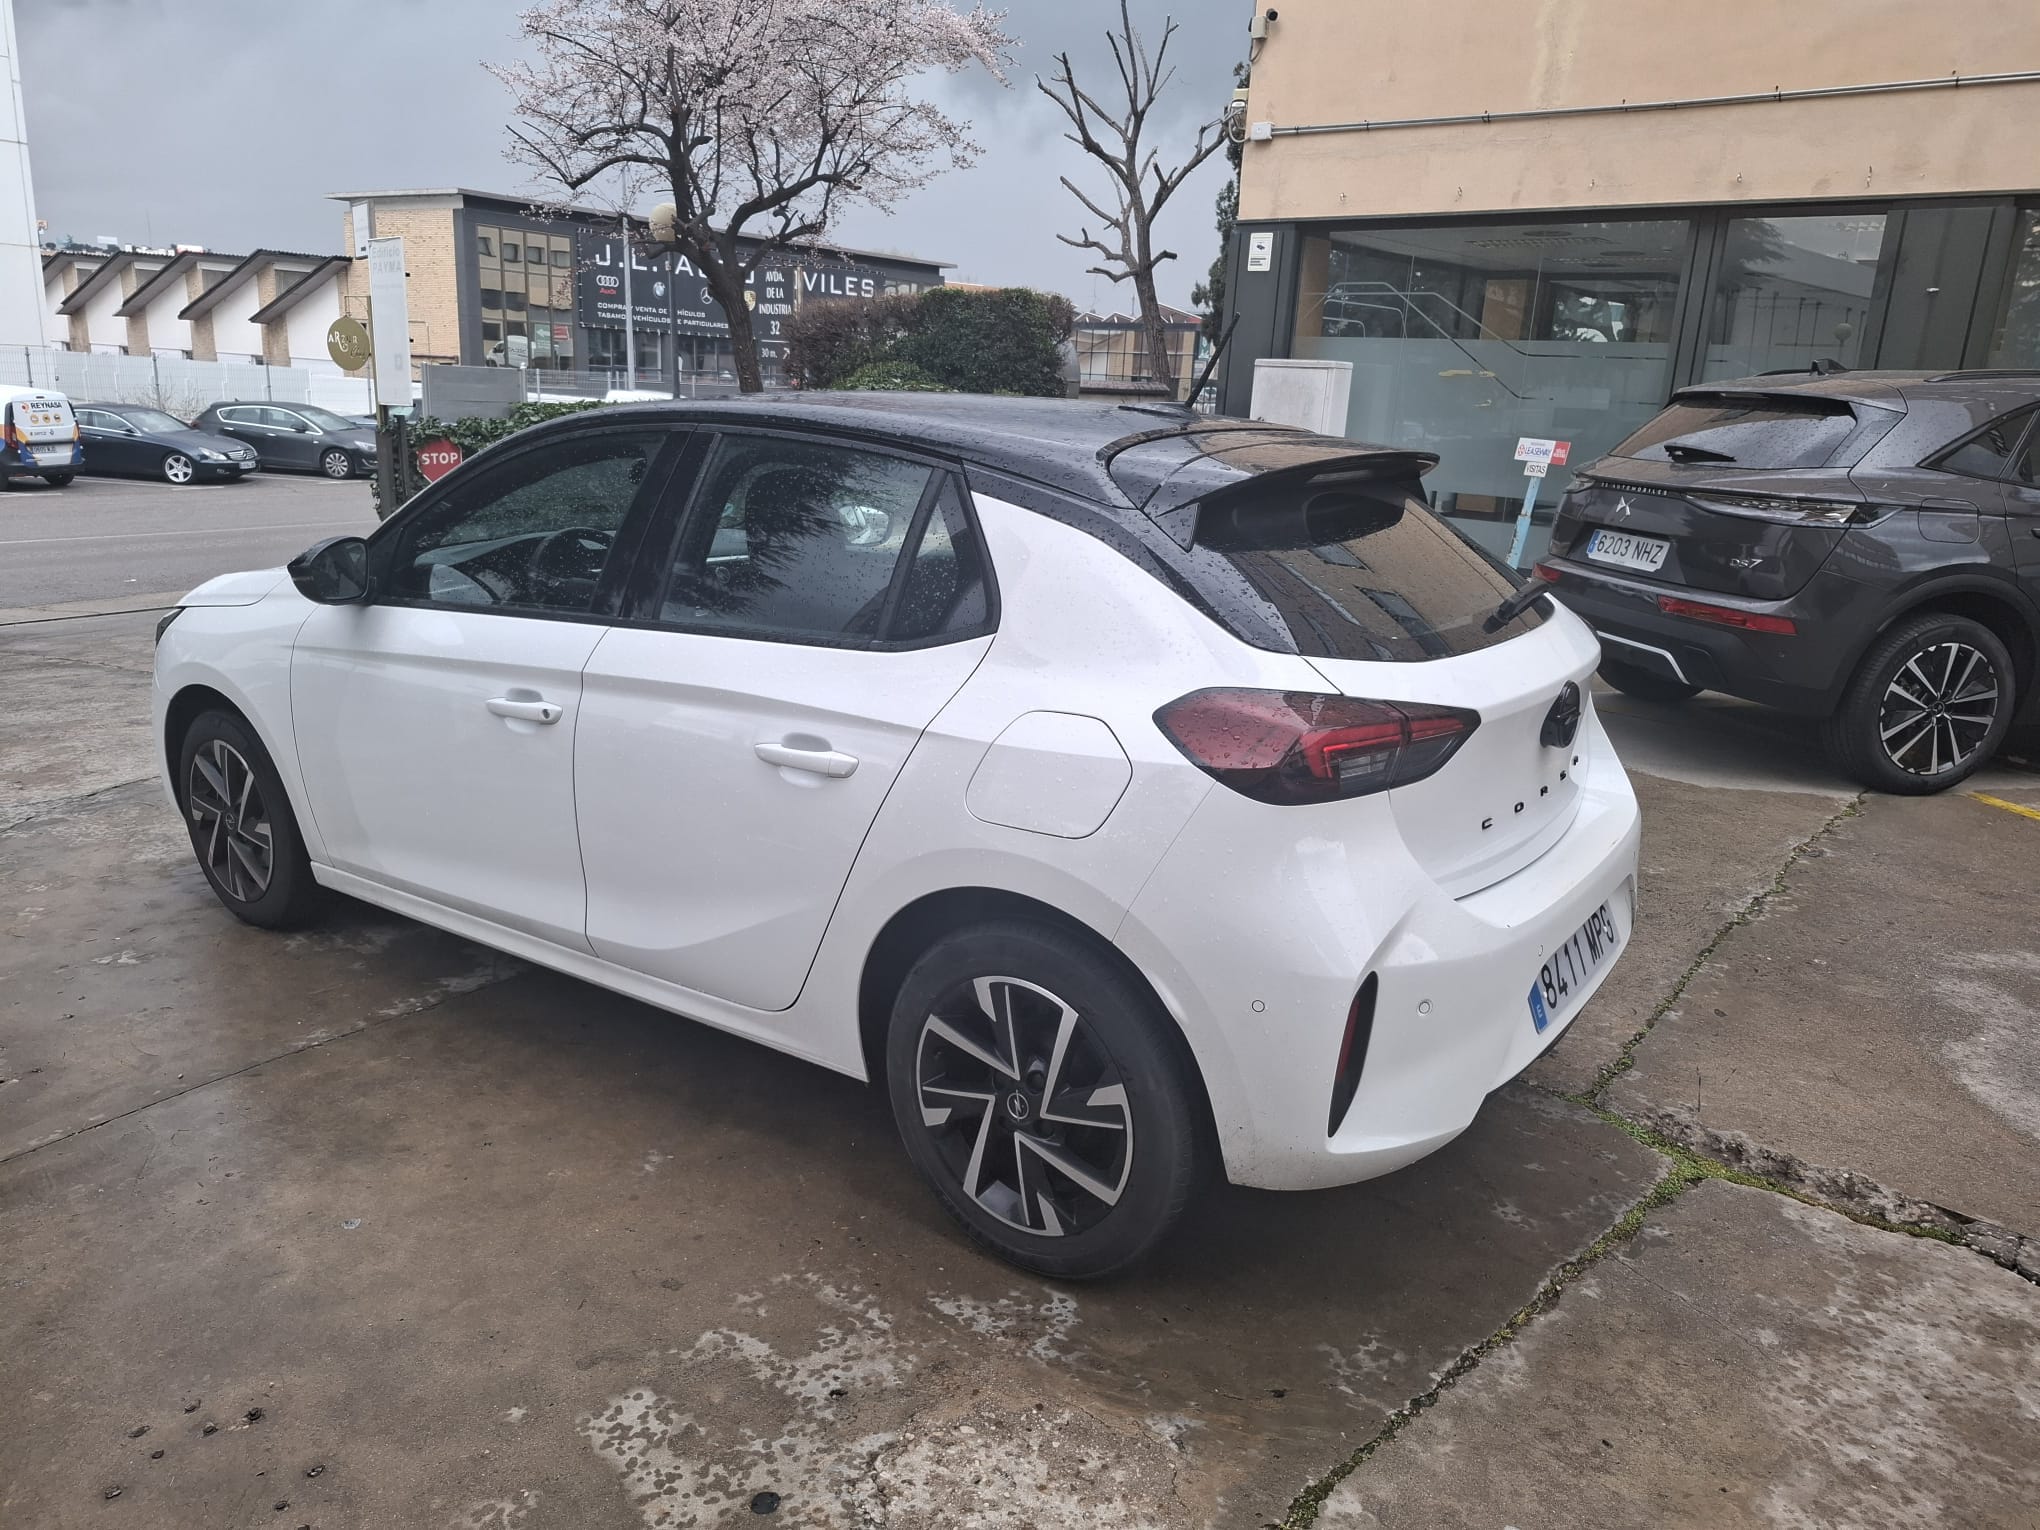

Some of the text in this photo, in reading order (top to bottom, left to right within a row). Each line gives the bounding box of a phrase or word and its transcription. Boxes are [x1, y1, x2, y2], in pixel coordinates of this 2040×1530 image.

[600, 287, 617, 295] Audi
[766, 287, 784, 299] DE LA
[597, 302, 627, 311] COMPRA
[759, 303, 792, 315] INDUSTRIA
[597, 311, 627, 320] TASAMO
[683, 319, 729, 329] PARTICULARES
[770, 320, 780, 335] 32
[31, 401, 63, 409] REYNASA
[421, 452, 459, 465] STOP
[1597, 534, 1664, 564] 6203 NHZ
[1541, 904, 1614, 1009] 8411 MPG
